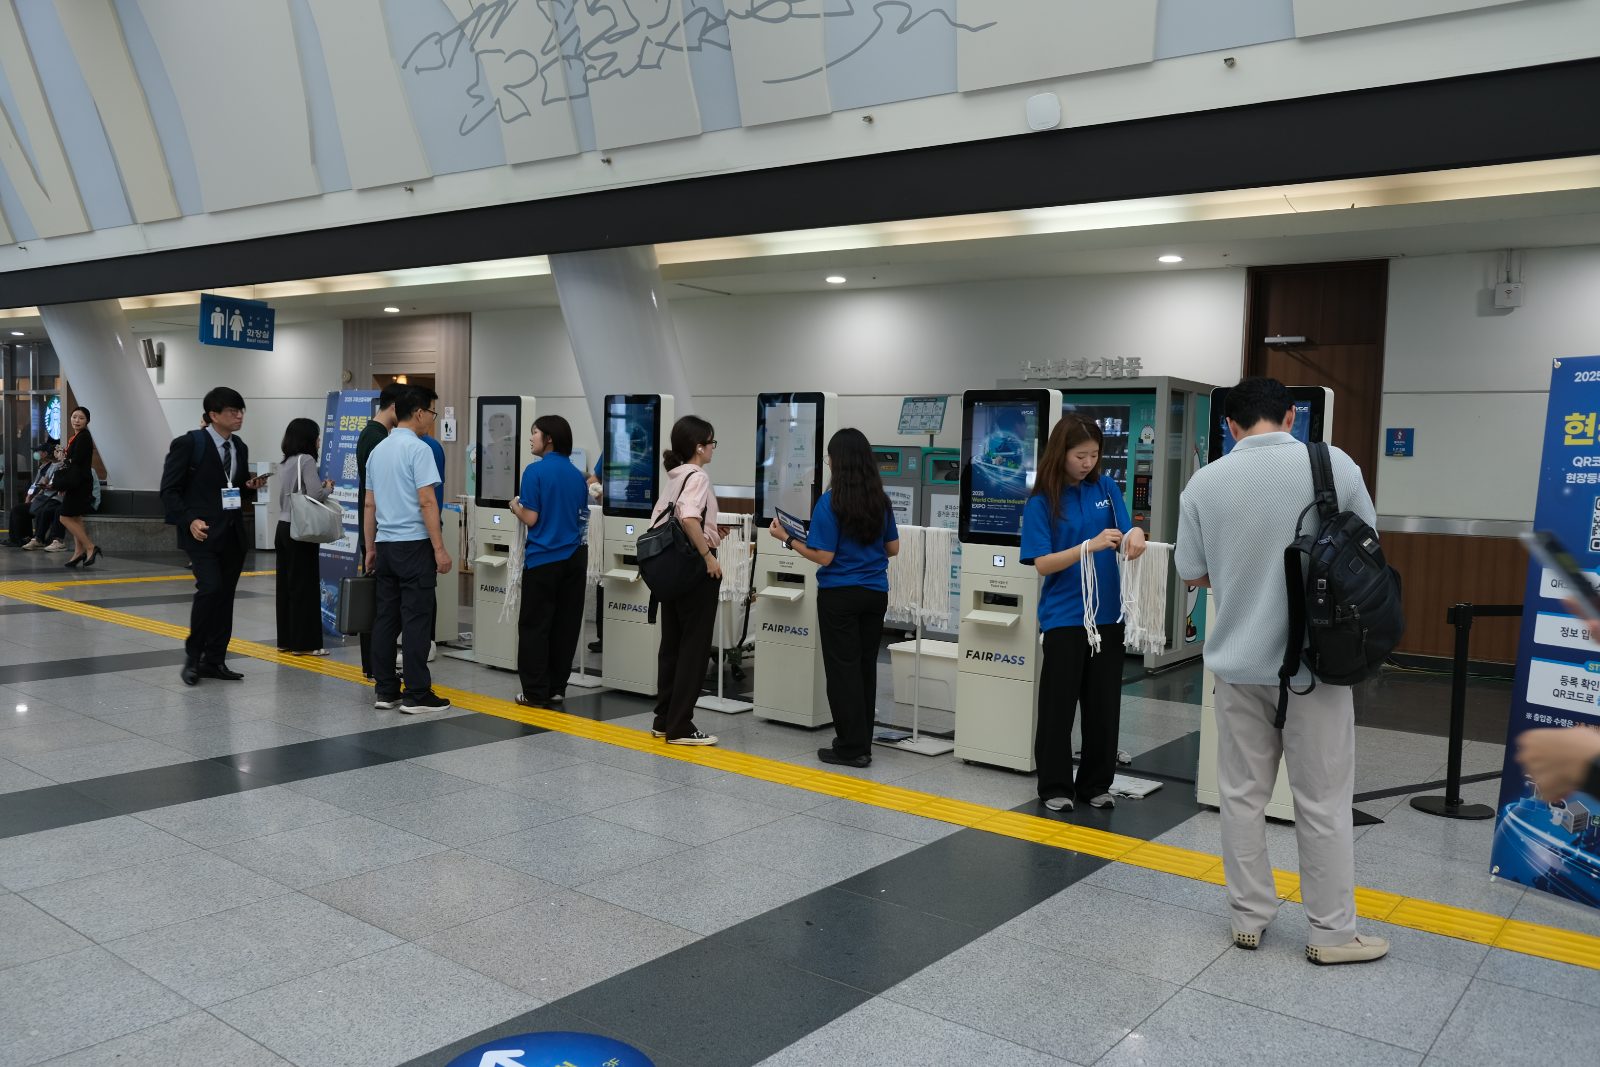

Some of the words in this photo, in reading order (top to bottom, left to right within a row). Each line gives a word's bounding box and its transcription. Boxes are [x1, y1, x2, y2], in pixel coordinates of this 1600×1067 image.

[246, 328, 270, 339] 화장실
[1574, 370, 1600, 383] 2025
[1564, 412, 1600, 446] 현
[608, 601, 648, 613] FAIRPASS
[762, 622, 809, 636] FAIRPASS
[1560, 626, 1579, 638] 정보
[1581, 629, 1593, 641] 입
[965, 649, 1025, 666] FAIRPASS
[1560, 675, 1579, 688] 등록
[1580, 678, 1600, 692] 확인
[1552, 688, 1595, 704] QR코드로
[1533, 713, 1553, 724] 출입증
[1553, 717, 1574, 729] 수령은
